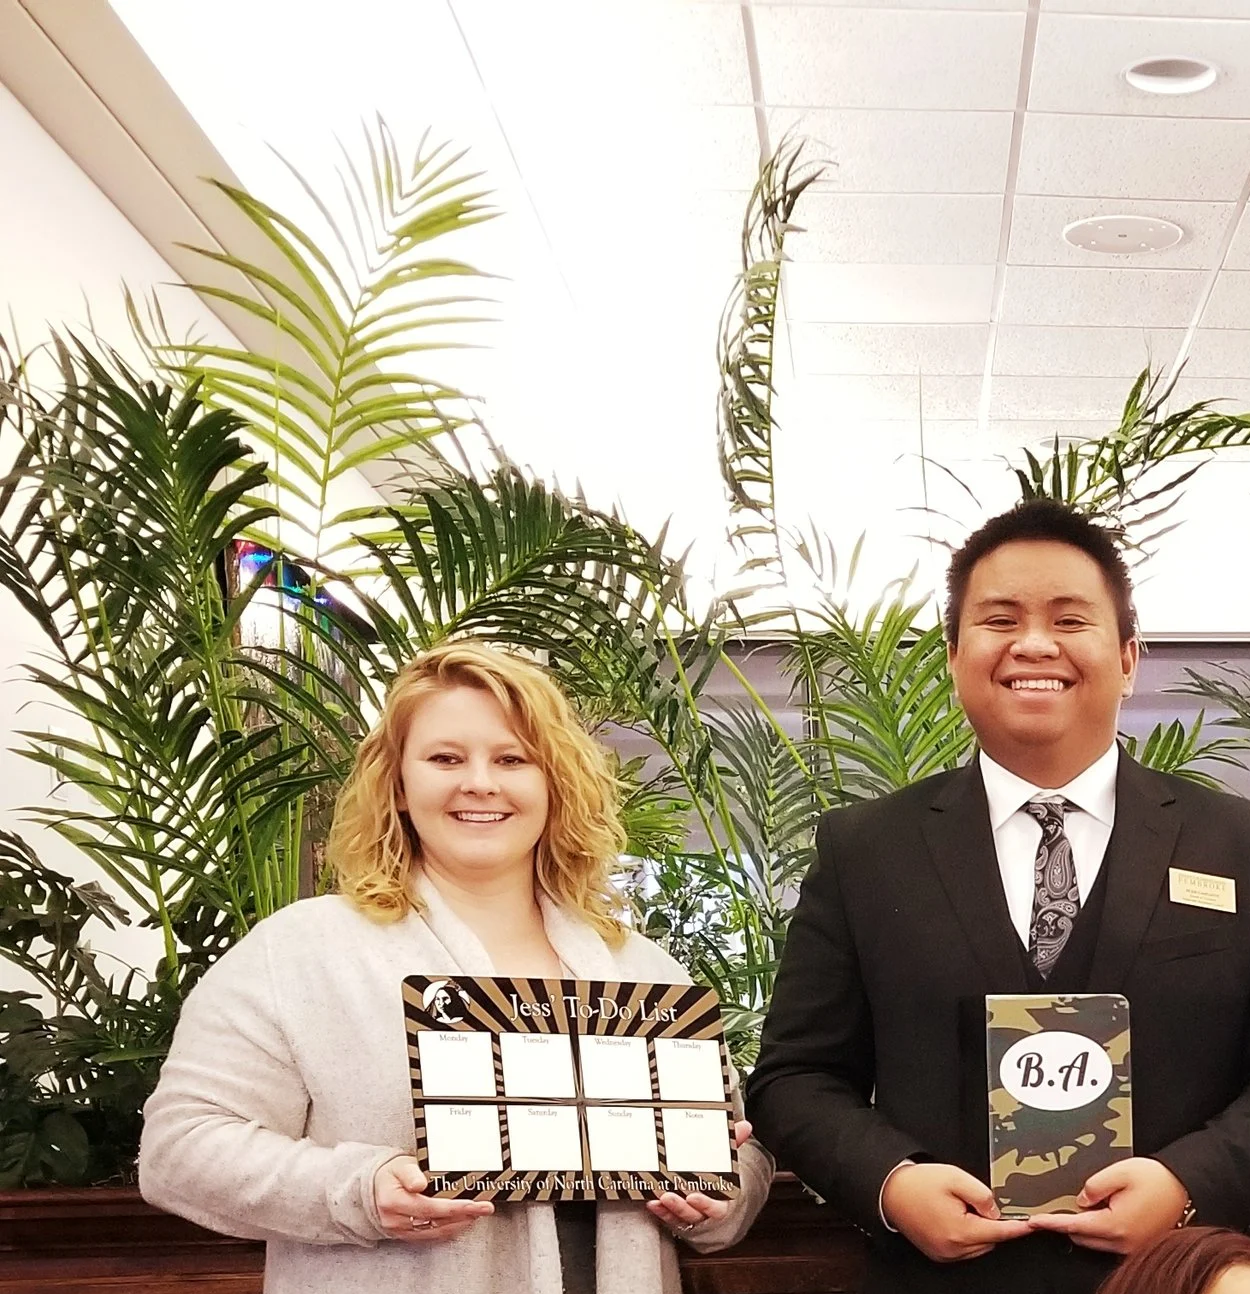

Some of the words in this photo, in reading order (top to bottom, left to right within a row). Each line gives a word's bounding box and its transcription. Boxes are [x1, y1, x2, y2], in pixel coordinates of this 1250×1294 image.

[509, 993, 555, 1021] Jess'
[563, 995, 633, 1020] To-Do
[639, 999, 678, 1022] List
[439, 1034, 468, 1044] Monday
[594, 1038, 631, 1047] Wednesday
[1016, 1051, 1098, 1091] B.A.
[449, 1107, 472, 1117] Friday
[608, 1109, 632, 1119] Sunday
[430, 1176, 459, 1191] The
[462, 1175, 532, 1194] University
[535, 1175, 550, 1191] of
[554, 1175, 594, 1191] North
[598, 1175, 655, 1191] Carolina
[657, 1178, 670, 1191] at
[673, 1177, 734, 1193] Pembroke
